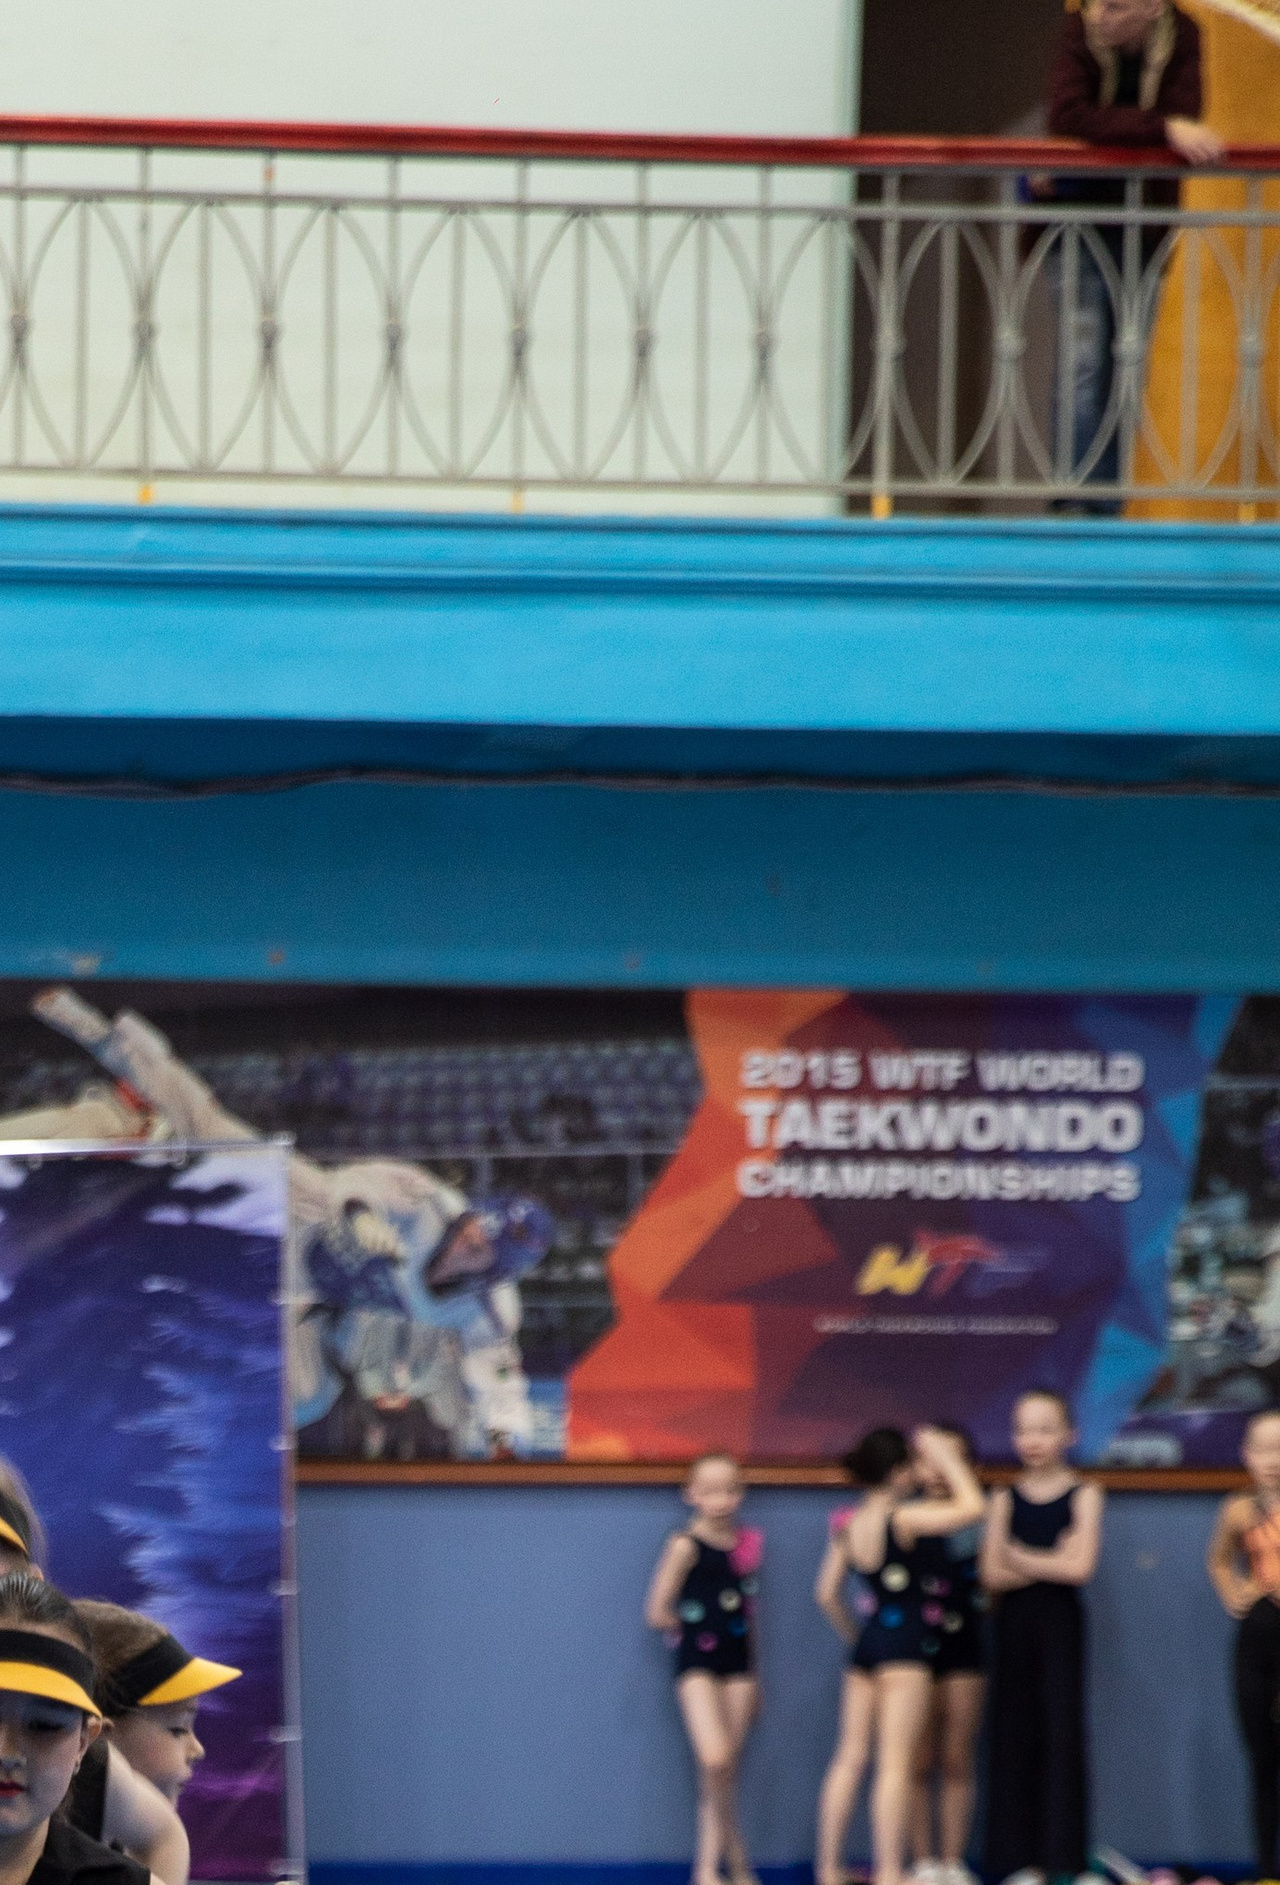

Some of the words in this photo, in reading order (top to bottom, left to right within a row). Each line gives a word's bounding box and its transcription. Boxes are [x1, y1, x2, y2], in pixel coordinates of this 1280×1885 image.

[741, 1051, 860, 1092] 2015
[871, 1051, 970, 1092] WTF
[977, 1051, 1144, 1093] WORLD
[739, 1100, 1142, 1152] TAEKWONDO
[737, 1161, 1141, 1200] CHAMPIONSHIPS
